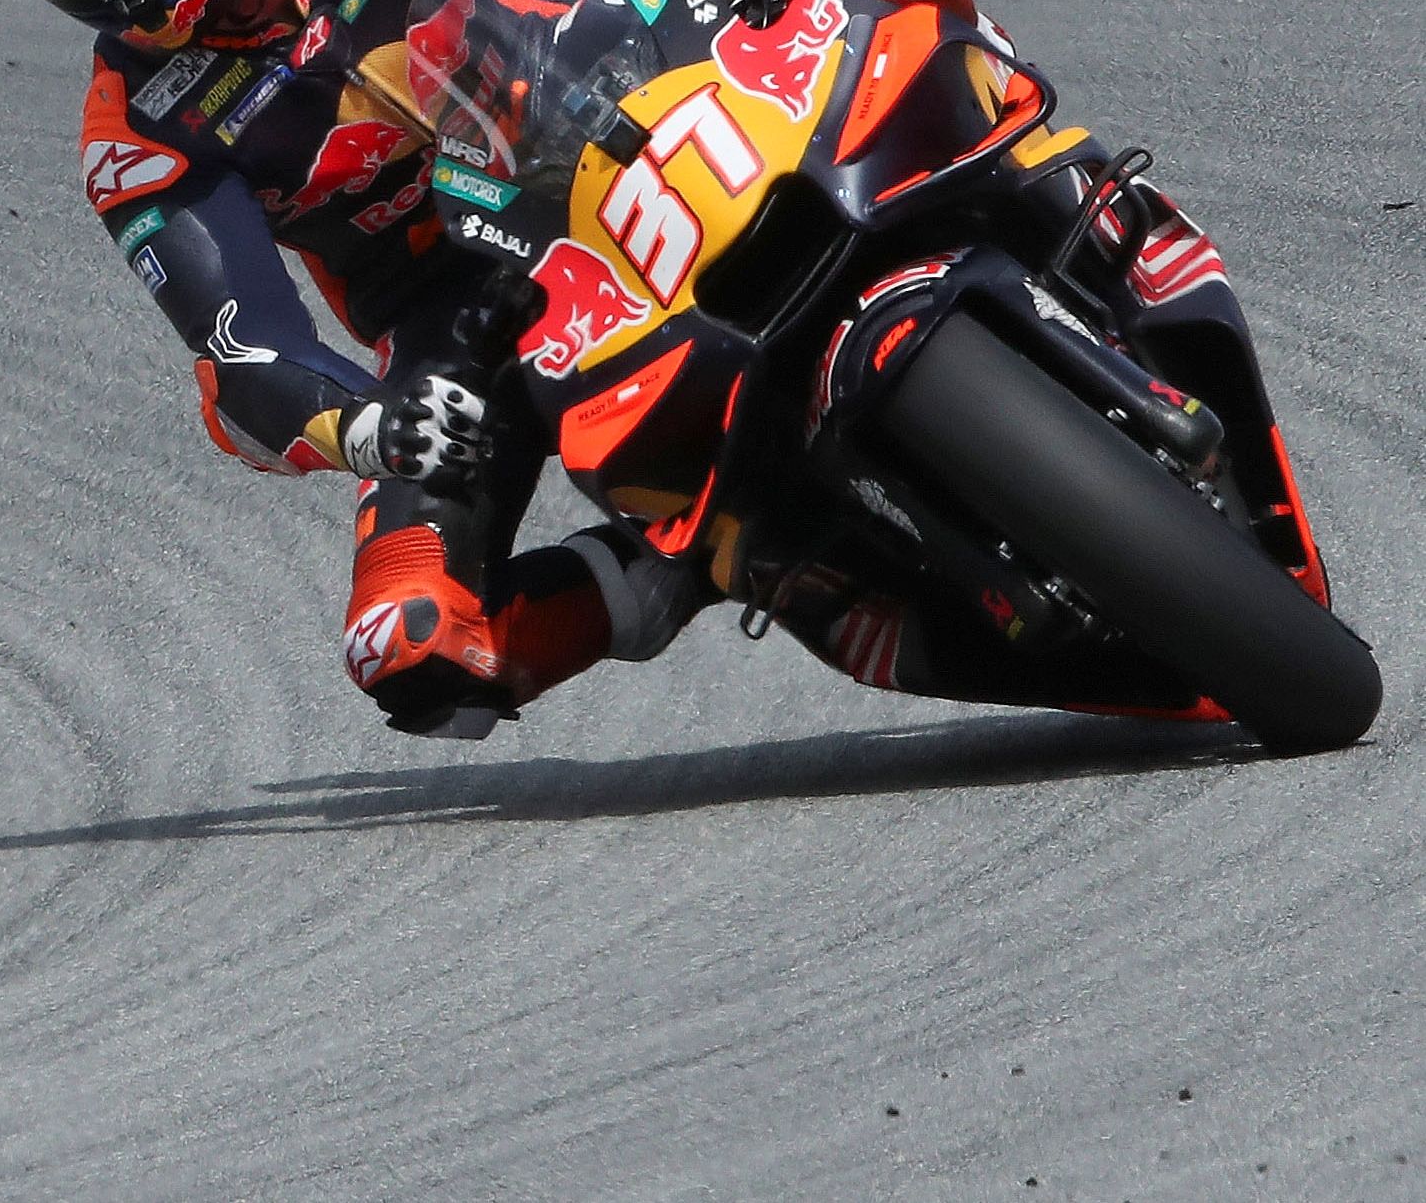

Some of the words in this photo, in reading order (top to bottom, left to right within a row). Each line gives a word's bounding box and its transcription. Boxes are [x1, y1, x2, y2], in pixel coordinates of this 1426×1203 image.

[451, 173, 502, 206] MOTOREX
[598, 81, 766, 309] 37
[480, 224, 531, 258] BAJAJ
